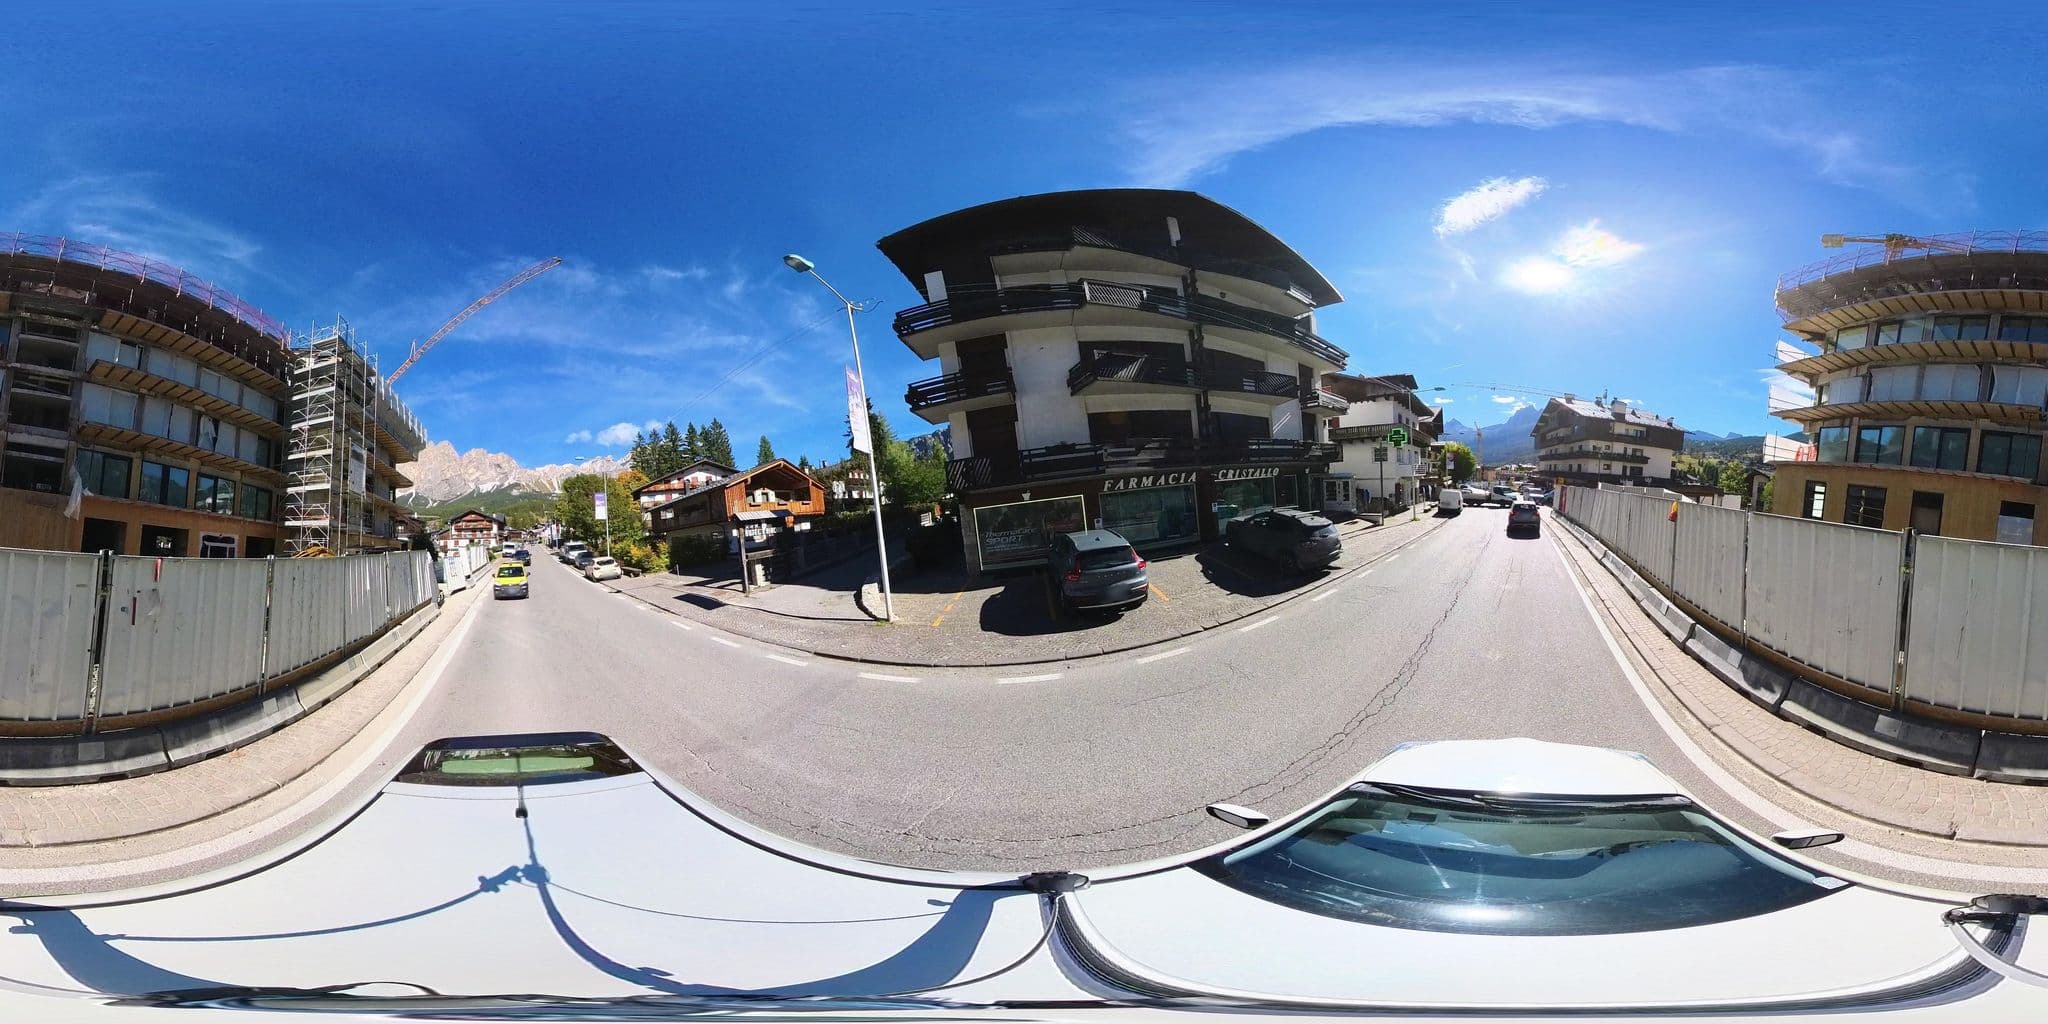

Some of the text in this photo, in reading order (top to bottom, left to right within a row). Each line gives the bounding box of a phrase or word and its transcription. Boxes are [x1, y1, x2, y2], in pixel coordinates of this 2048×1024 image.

[1103, 467, 1280, 492] FARMACIA CRISTALLO
[984, 535, 1024, 545] SPORT
